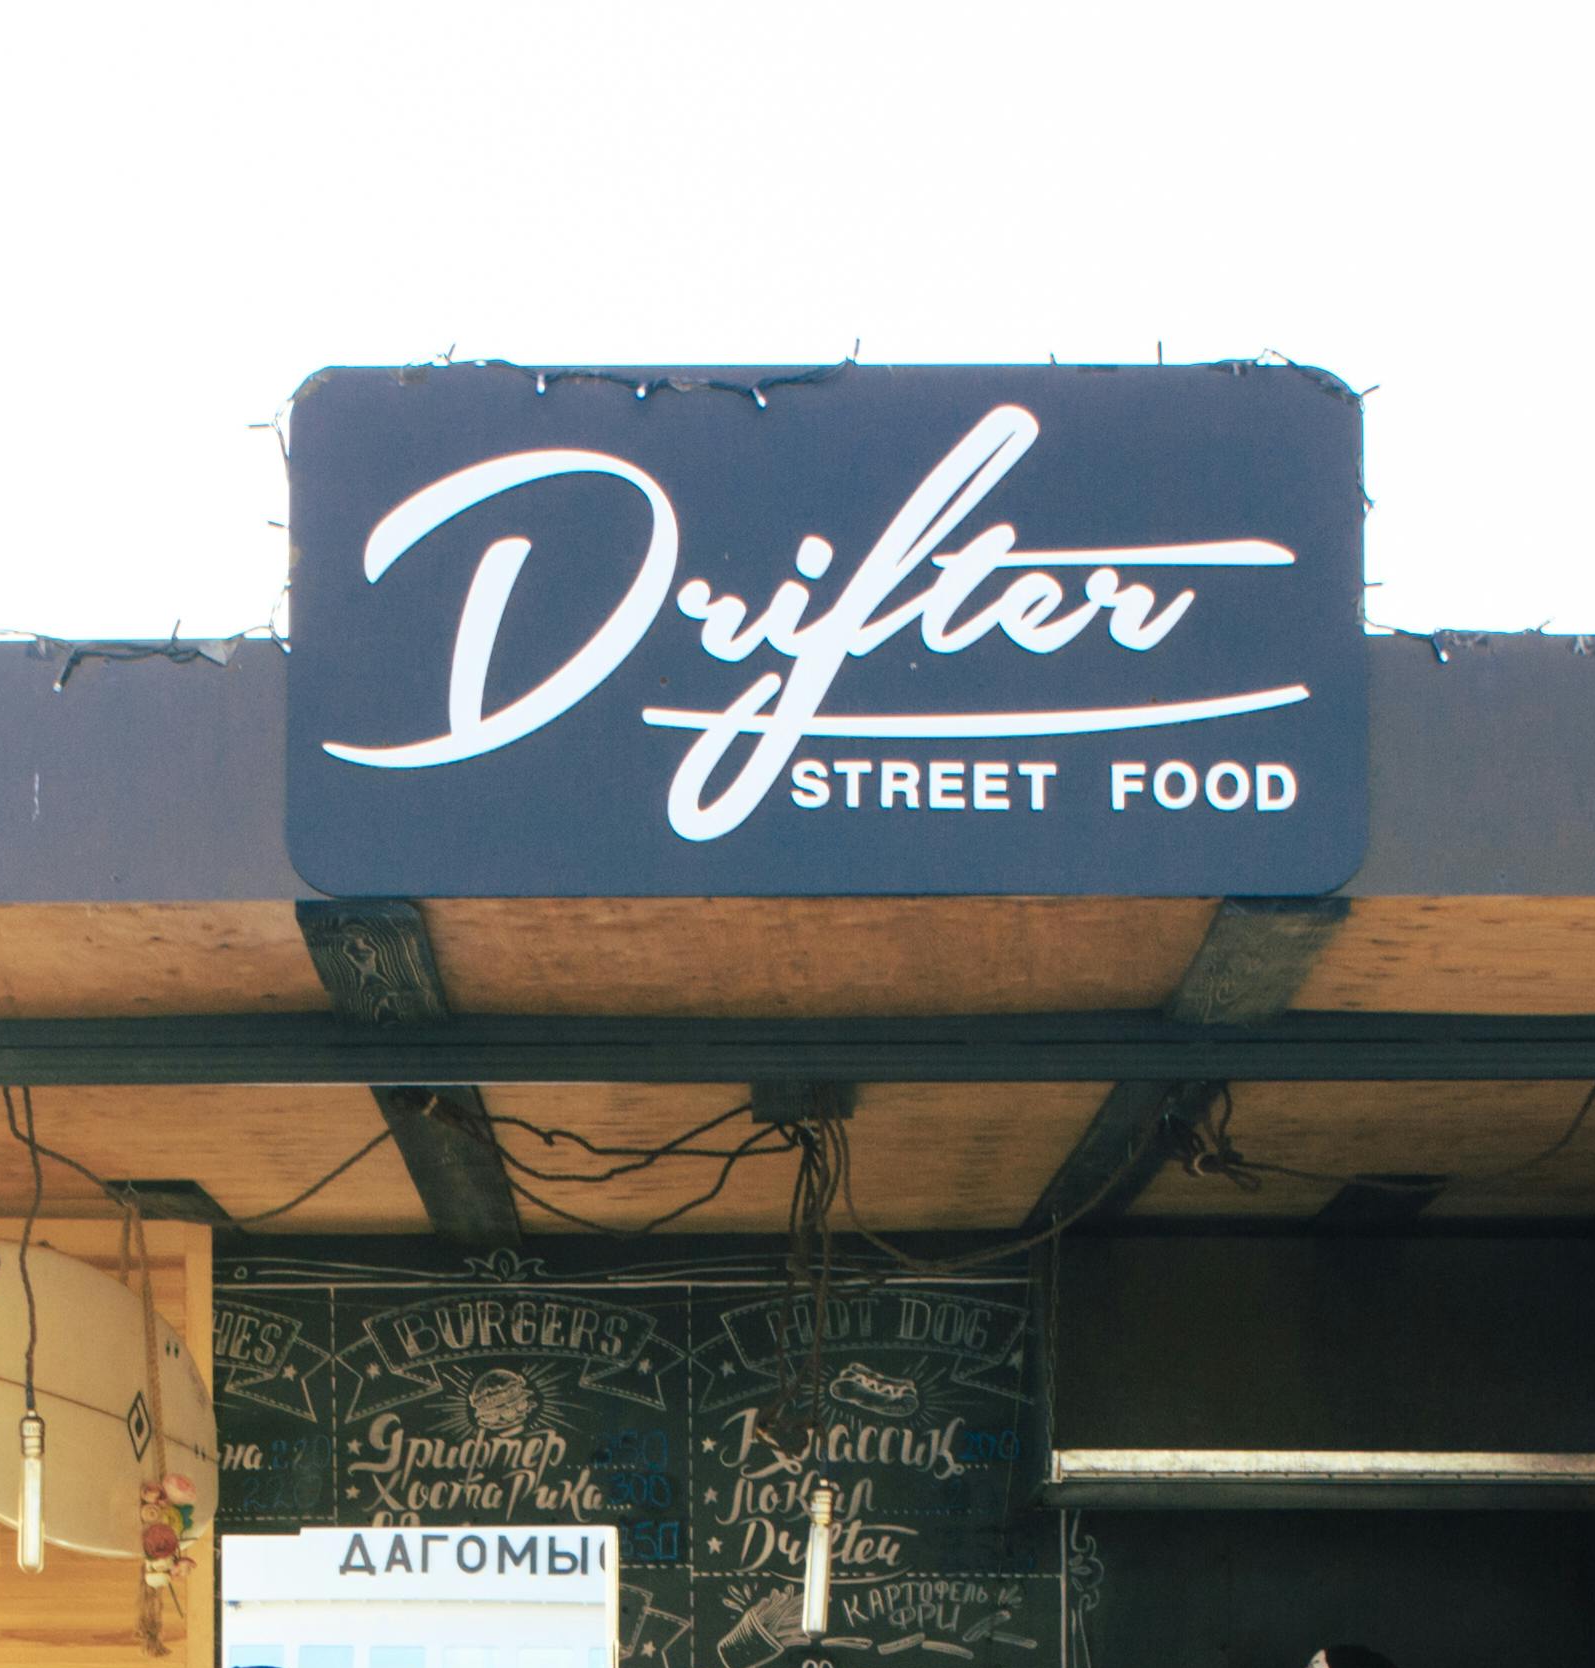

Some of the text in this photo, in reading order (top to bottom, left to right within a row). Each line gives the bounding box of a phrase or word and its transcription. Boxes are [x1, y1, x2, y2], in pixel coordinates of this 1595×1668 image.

[322, 405, 1296, 842] Drifter
[791, 760, 1297, 812] STREET FOOD
[212, 1309, 284, 1365] HES
[394, 1300, 630, 1359] BURGERS
[766, 1297, 994, 1350] HOT DOG
[347, 1412, 567, 1491] Дрифтер
[338, 1532, 606, 1577] ДАГОМЫ
[733, 1516, 918, 1573] Drter
[842, 1580, 989, 1628] КАРТОФЕЛЬ
[888, 1602, 961, 1633] ФРИ
